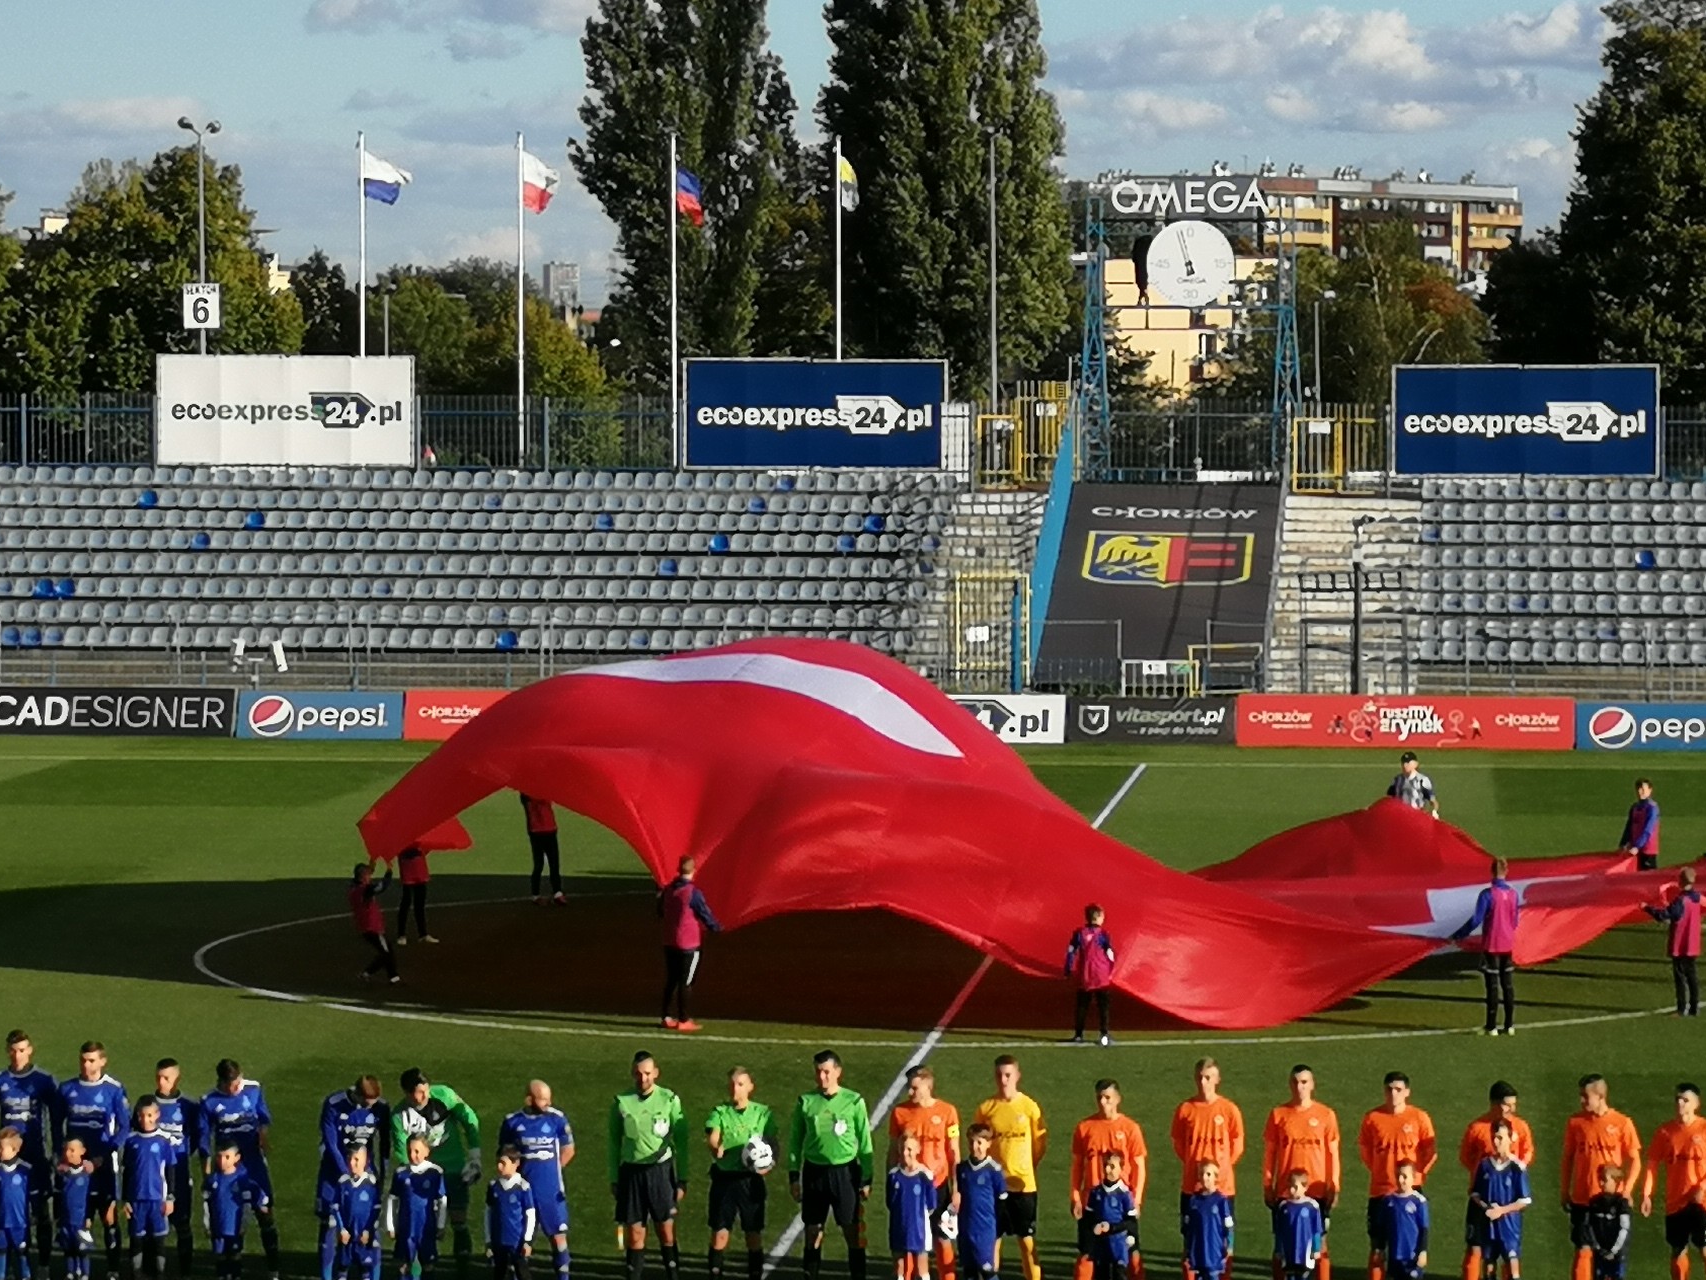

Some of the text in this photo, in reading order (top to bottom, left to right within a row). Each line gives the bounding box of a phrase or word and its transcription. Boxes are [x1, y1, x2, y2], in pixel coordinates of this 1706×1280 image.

[1111, 177, 1270, 215] OMEGA
[192, 297, 210, 324] 6
[171, 400, 402, 426] ecoexpress24.pl
[696, 403, 933, 432] ecoexpress24.pl
[1403, 409, 1646, 438] ecoexpress24.pl
[297, 702, 386, 732] pepsi
[1115, 706, 1226, 726] vitasport.pl
